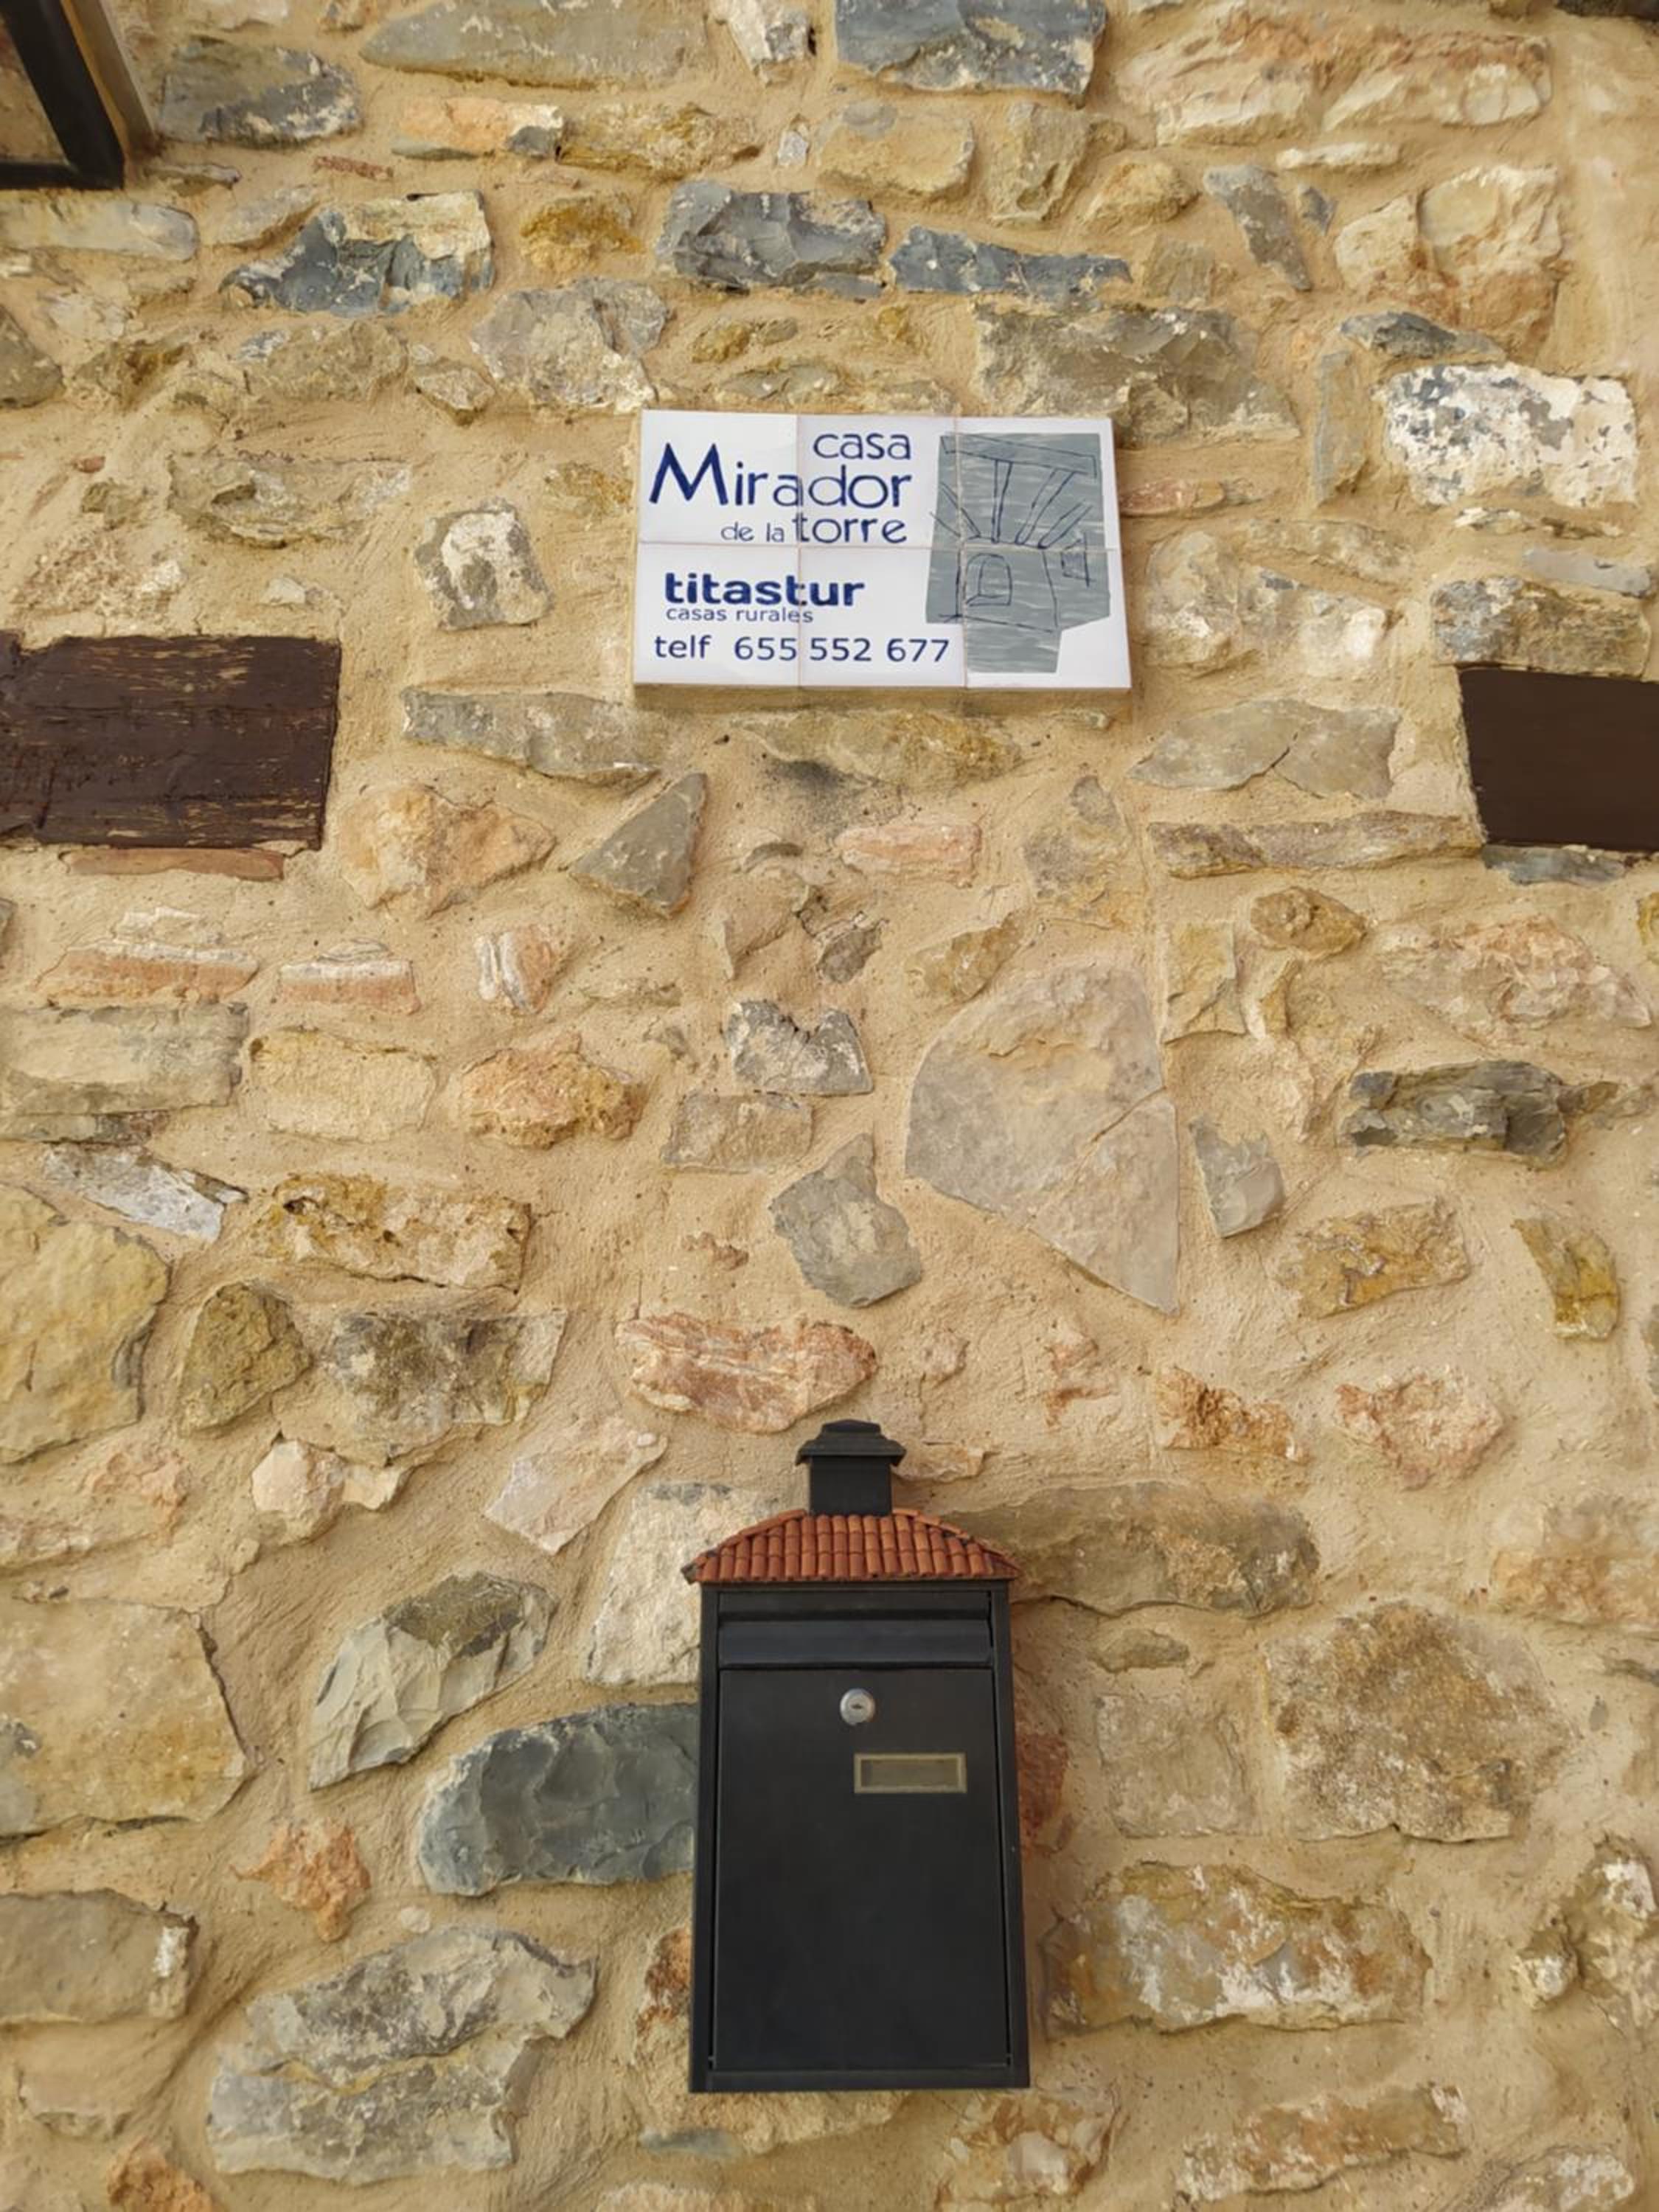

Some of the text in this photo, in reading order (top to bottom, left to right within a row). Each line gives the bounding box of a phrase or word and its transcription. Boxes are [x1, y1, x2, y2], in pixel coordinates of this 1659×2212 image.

[813, 432, 911, 460] casa
[648, 442, 913, 509] Mirador
[720, 512, 908, 543] de la torre
[664, 572, 865, 606] titastur
[666, 608, 813, 623] casas rurales
[655, 634, 950, 662] telf 655 552 677
